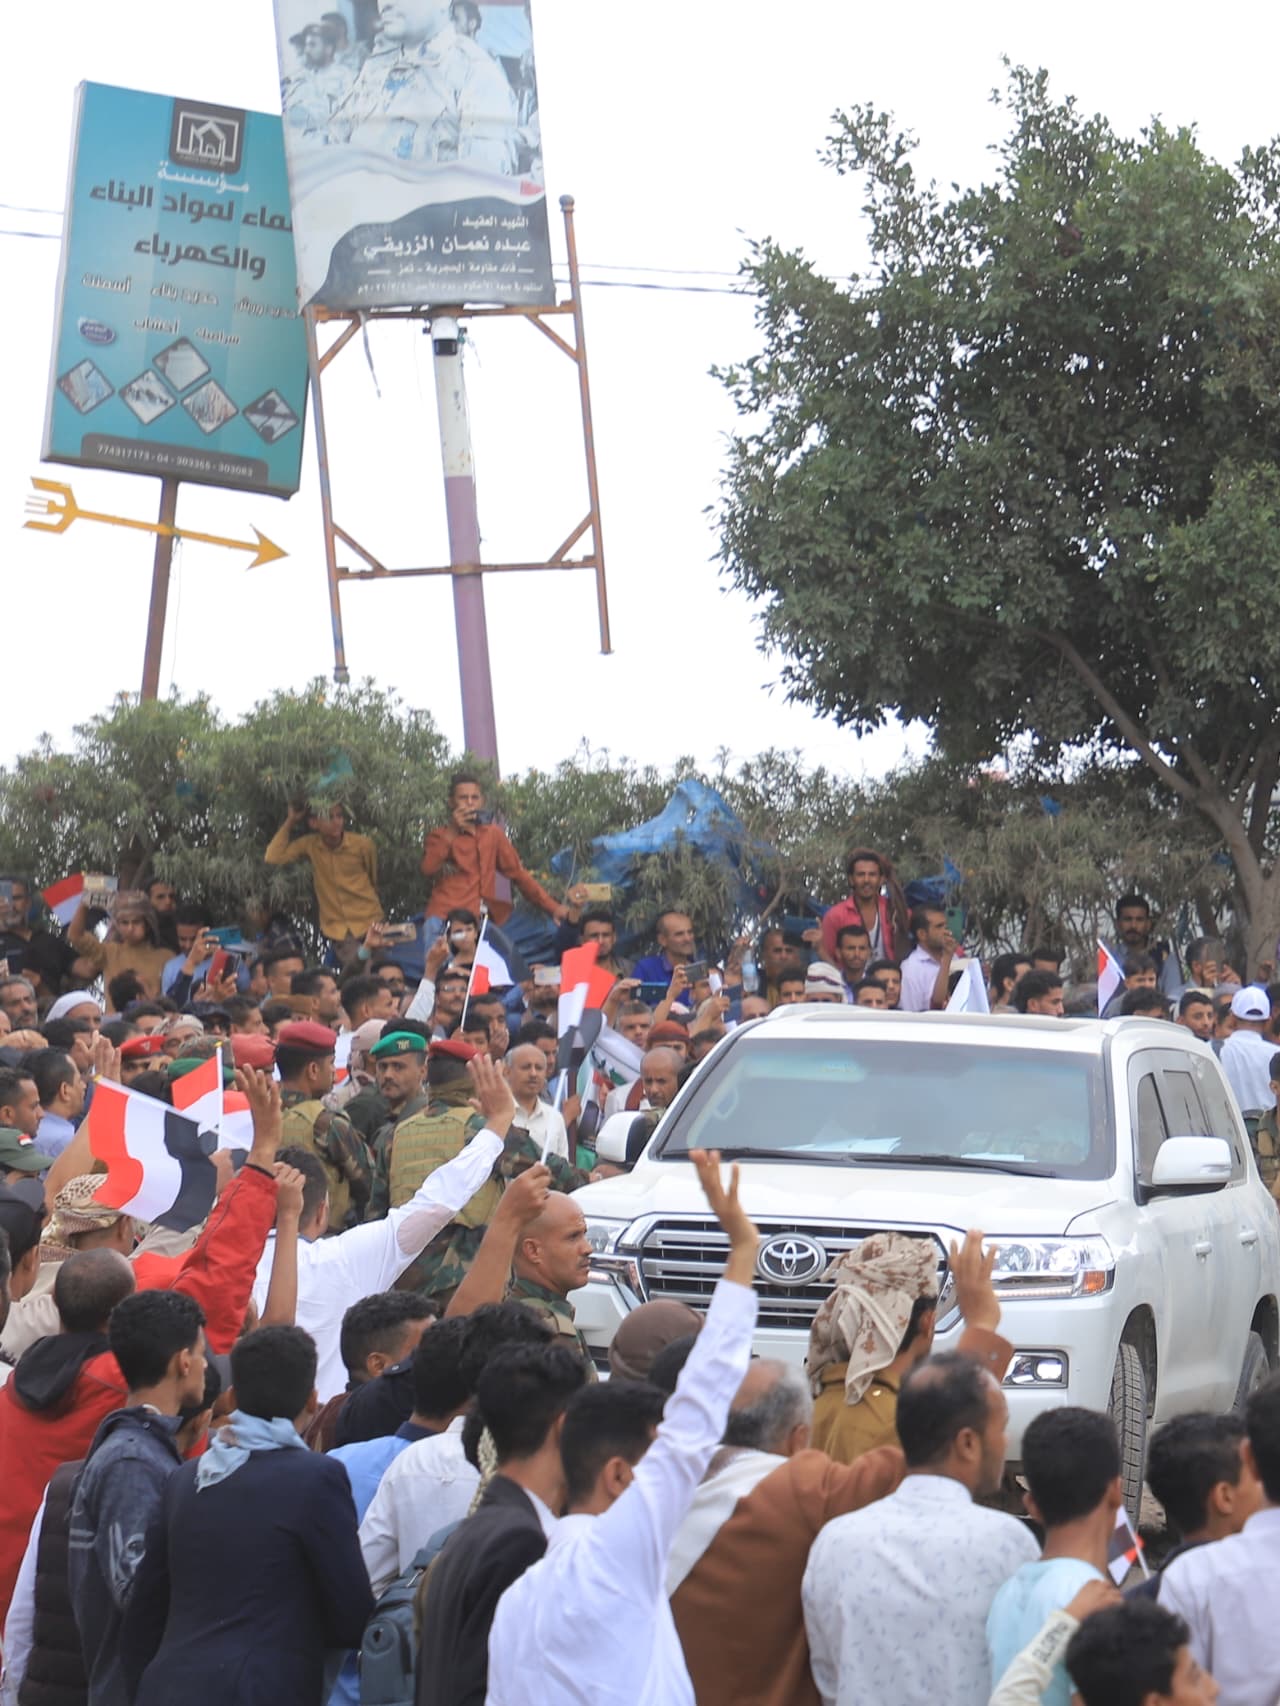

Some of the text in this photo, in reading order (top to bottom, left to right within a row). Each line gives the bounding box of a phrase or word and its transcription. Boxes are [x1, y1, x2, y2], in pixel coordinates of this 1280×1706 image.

[157, 160, 250, 194] مؤسسة
[89, 180, 293, 233] ماء لمواد البناء
[462, 215, 498, 230] العقيد
[501, 215, 529, 230] الشهيد
[441, 235, 490, 255] نعمان
[495, 236, 532, 257] عبده
[134, 233, 266, 280] والكهرباء
